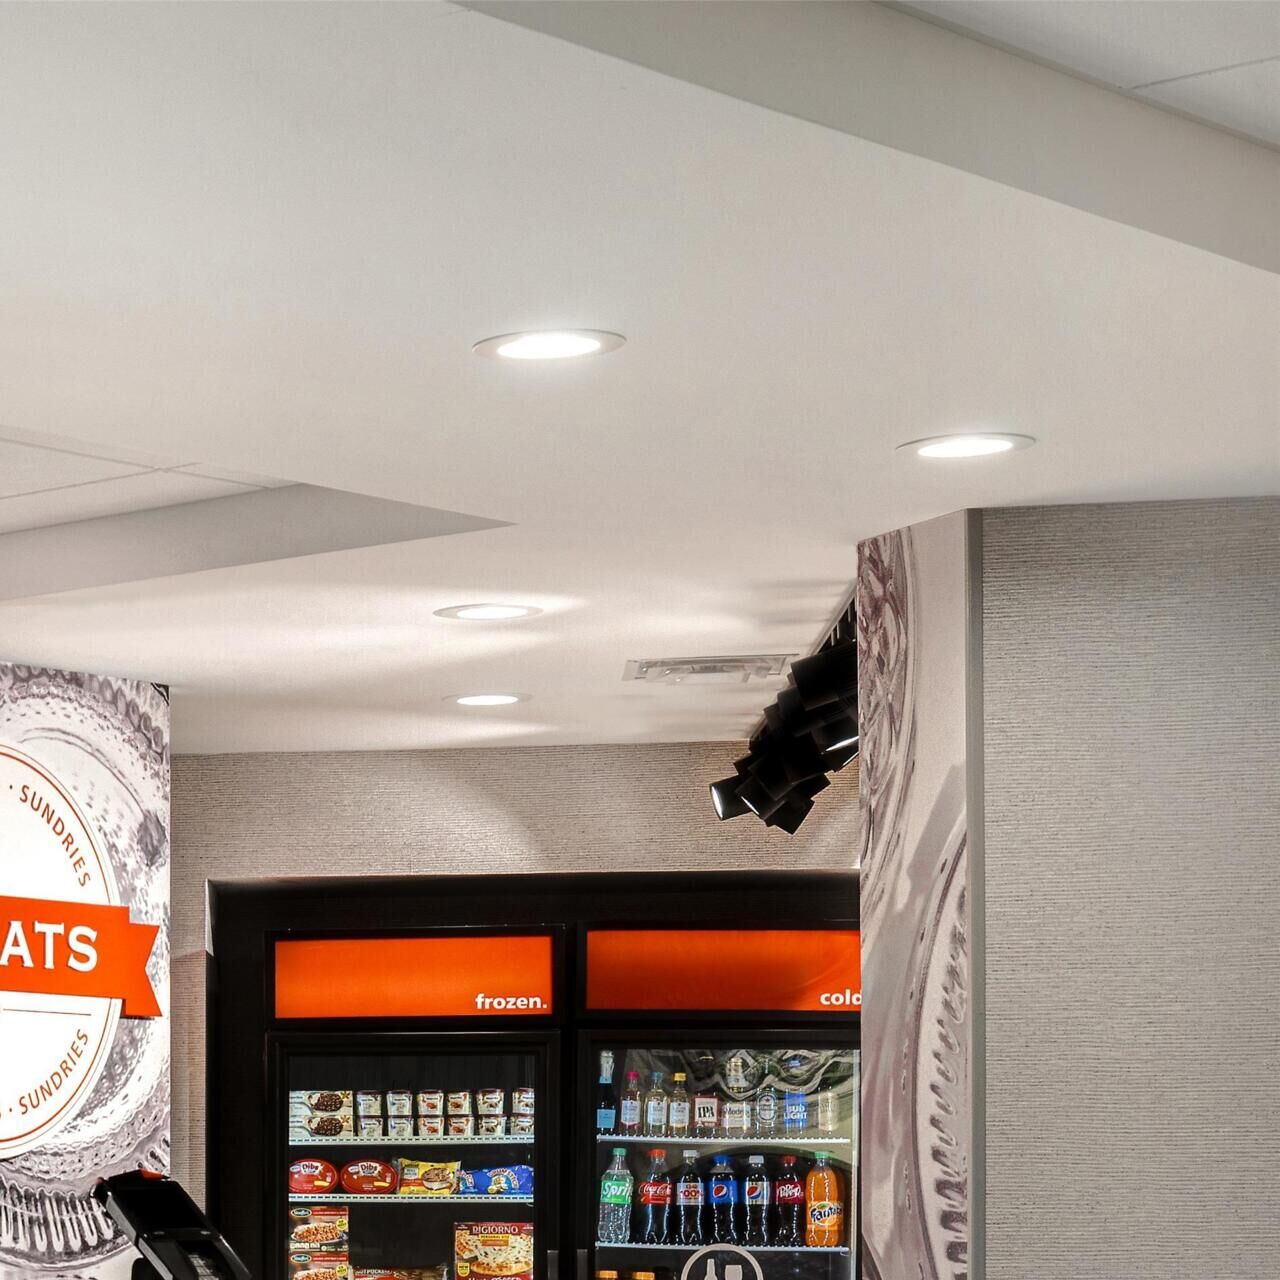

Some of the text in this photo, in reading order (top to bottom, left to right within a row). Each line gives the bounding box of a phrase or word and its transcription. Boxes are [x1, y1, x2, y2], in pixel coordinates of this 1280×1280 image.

[18, 784, 92, 888] SUNDRIES
[474, 992, 548, 1010] frozen.
[18, 1028, 89, 1116] SUNDRIES
